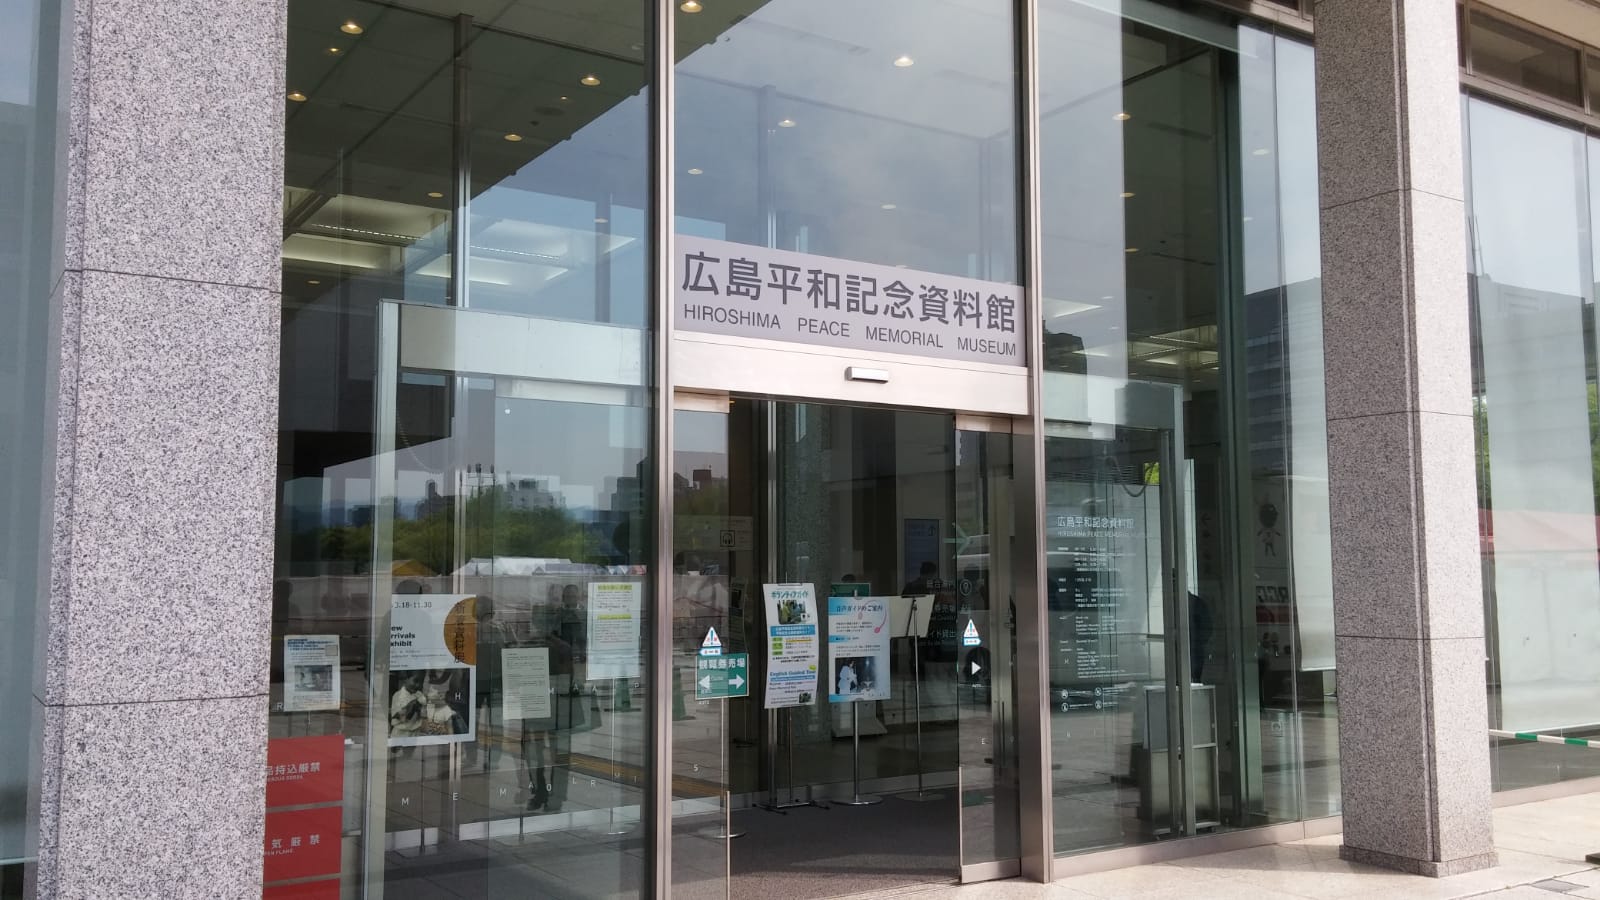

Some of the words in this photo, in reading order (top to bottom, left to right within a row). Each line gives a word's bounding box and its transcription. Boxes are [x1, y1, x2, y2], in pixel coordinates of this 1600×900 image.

[682, 251, 1016, 334] 広島平和記念資料館
[684, 304, 781, 329] HIROSHIMA
[798, 317, 850, 338] PEACE
[865, 326, 944, 348] MEMORIAL
[957, 337, 1017, 357] MUSEUM
[1057, 516, 1134, 529] 広島平和記念資料館
